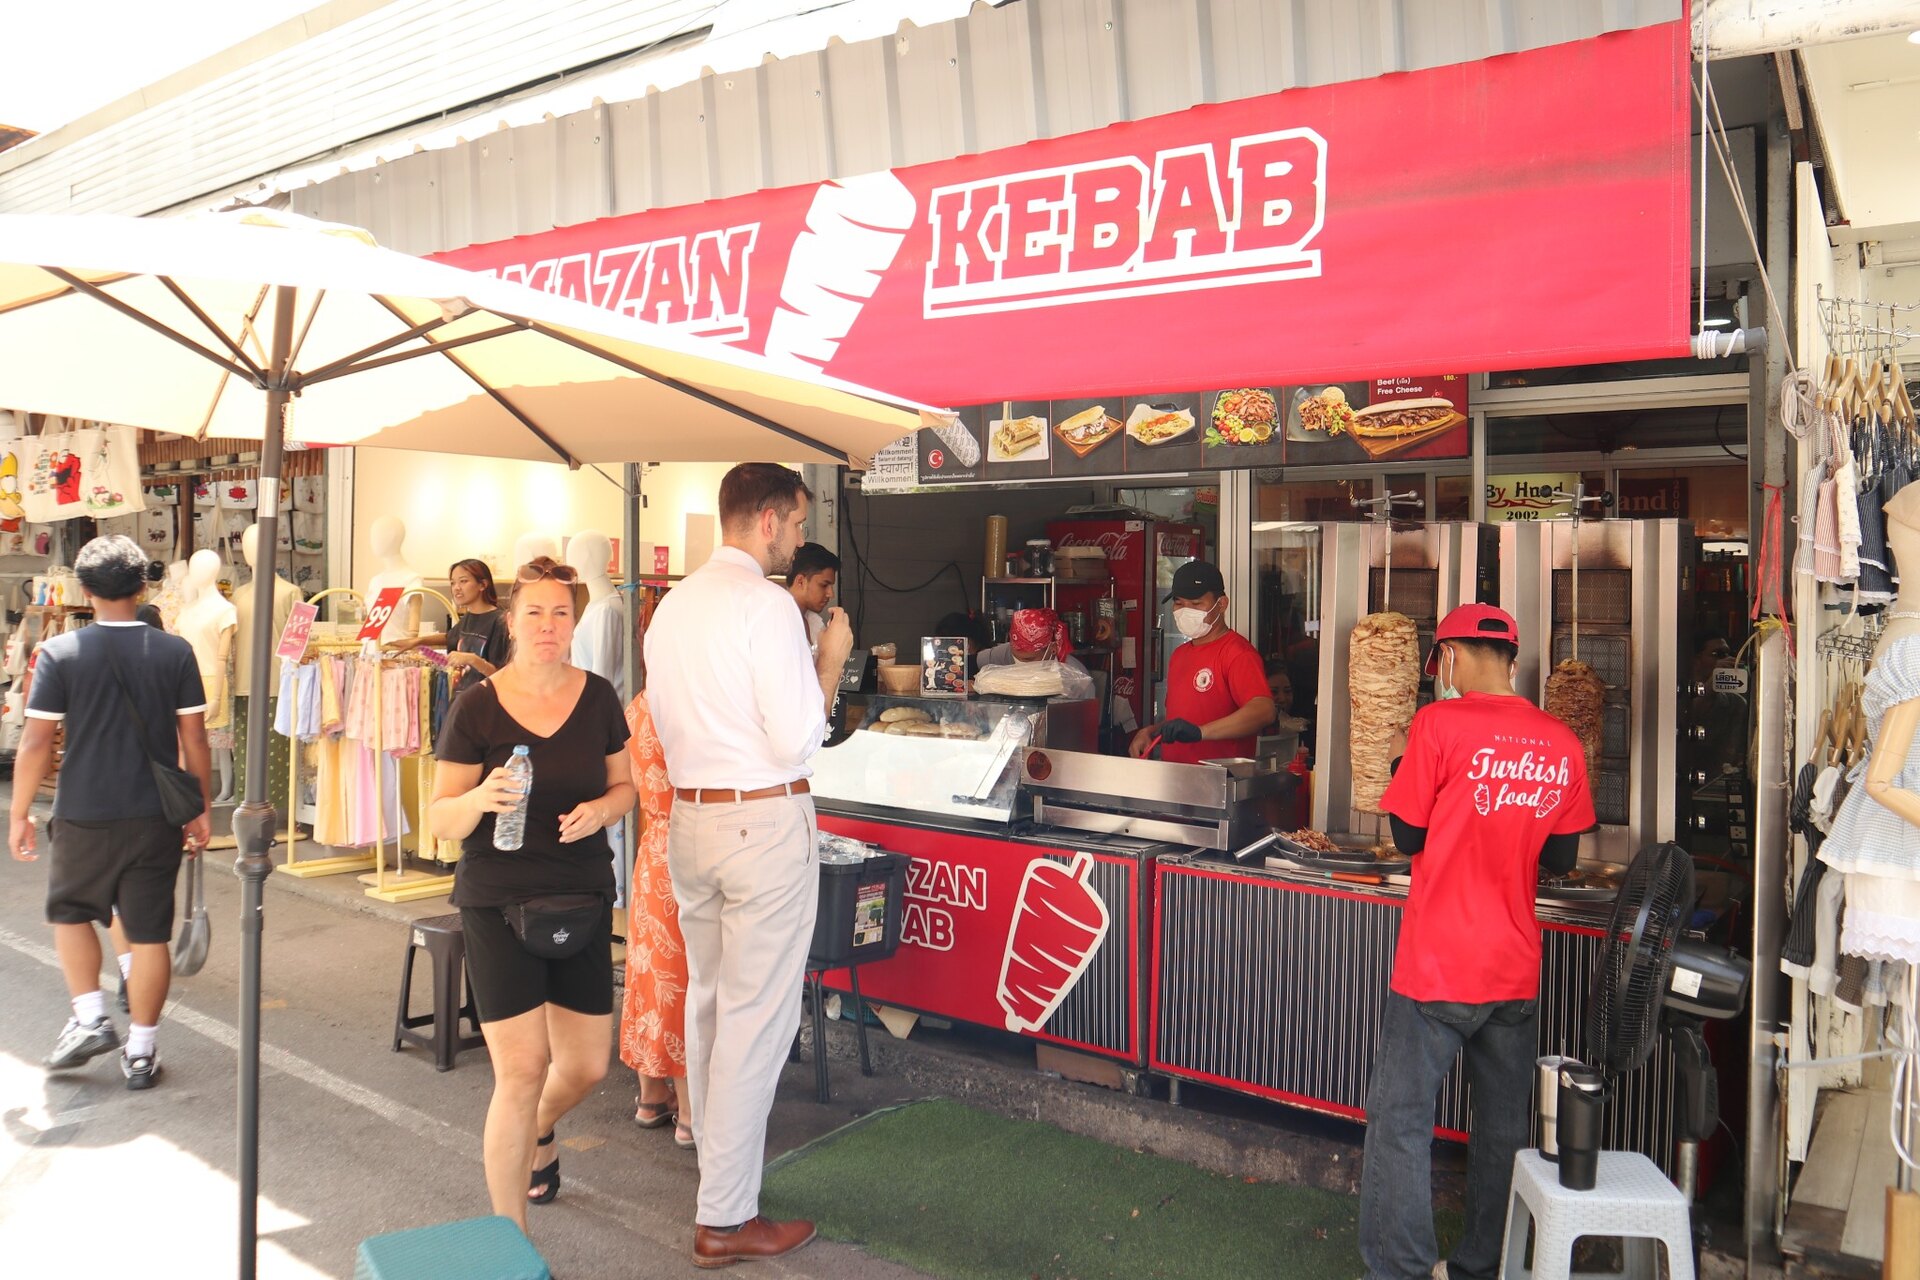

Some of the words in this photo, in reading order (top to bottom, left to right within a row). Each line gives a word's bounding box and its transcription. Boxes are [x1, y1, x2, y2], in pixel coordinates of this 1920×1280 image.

[924, 127, 1327, 302] KEBAB
[1377, 378, 1395, 386] Beef
[1395, 386, 1423, 394] Cheese
[867, 474, 914, 484] Willkommen!
[1506, 511, 1539, 521] 2002
[364, 605, 392, 628] 99
[1494, 735, 1552, 747] NATIONAL
[1466, 747, 1569, 787] Turkish
[1494, 783, 1543, 811] food
[899, 903, 955, 952] AB
